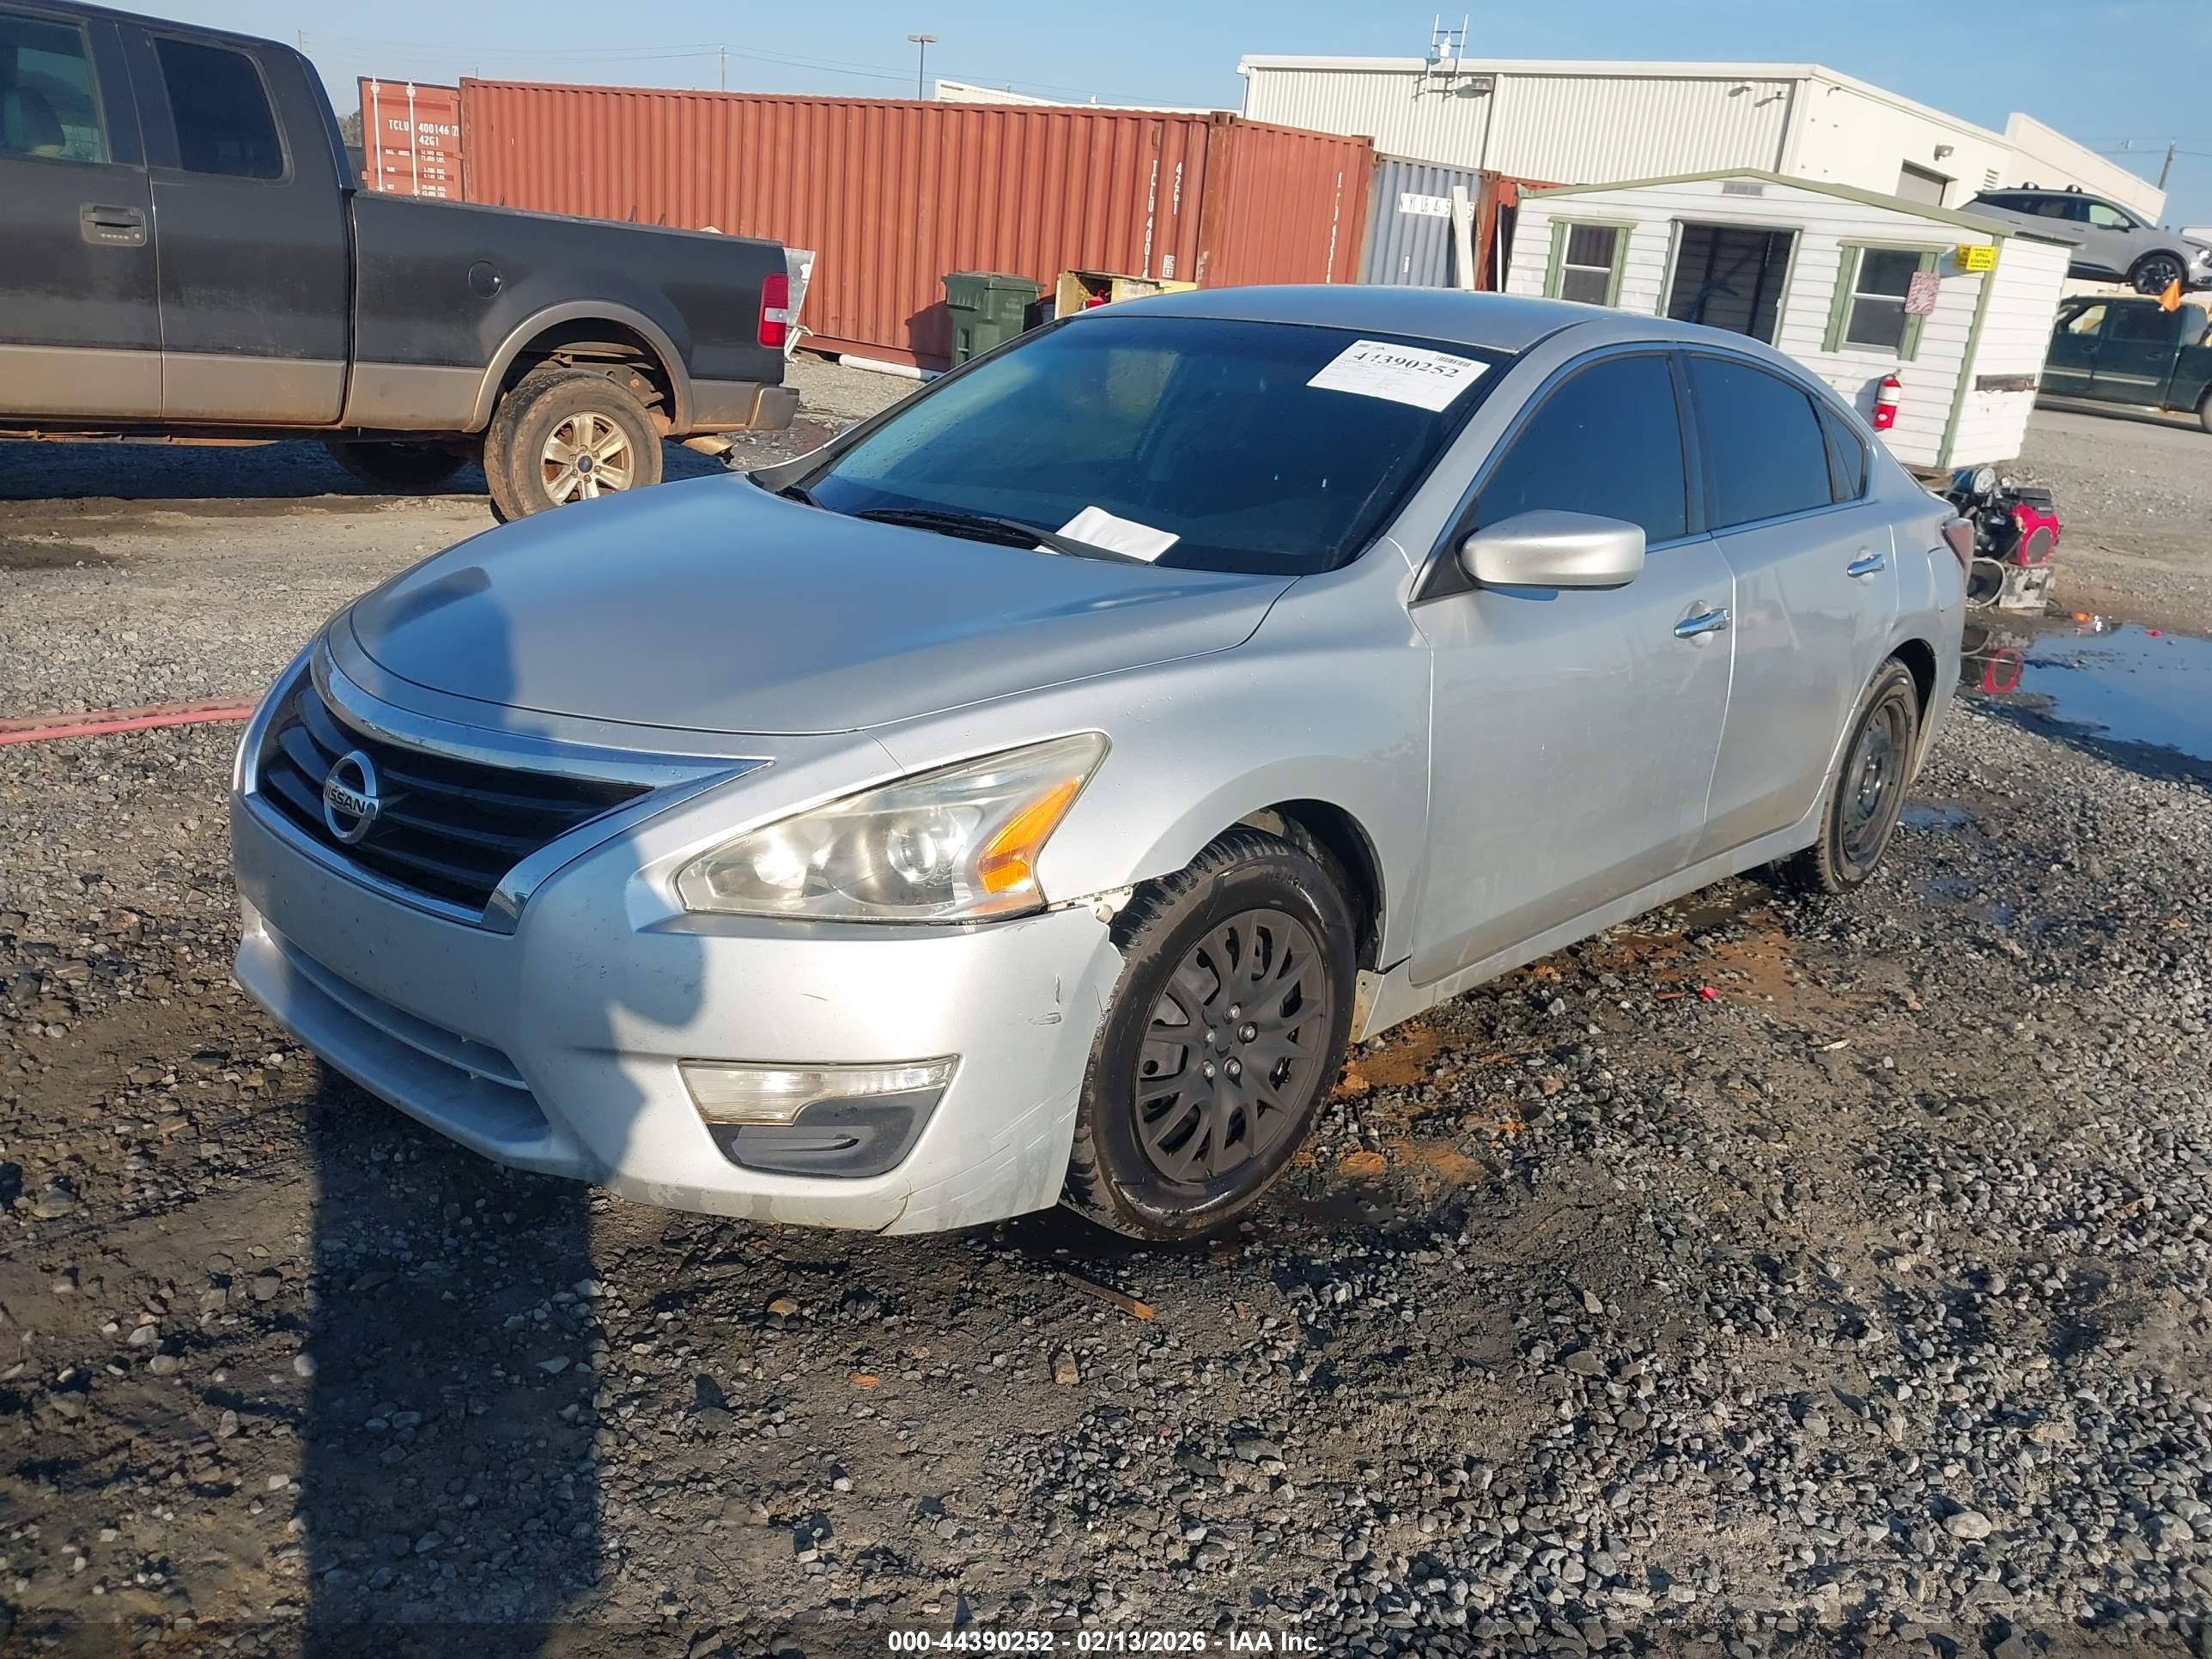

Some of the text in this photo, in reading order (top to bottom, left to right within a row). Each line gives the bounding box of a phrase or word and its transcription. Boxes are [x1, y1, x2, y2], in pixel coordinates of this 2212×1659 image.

[388, 119, 410, 131] TCLU
[418, 123, 449, 135] 400146
[418, 135, 439, 146] 42G1
[1148, 160, 1158, 213] TCLU
[1173, 161, 1182, 215] 42G1
